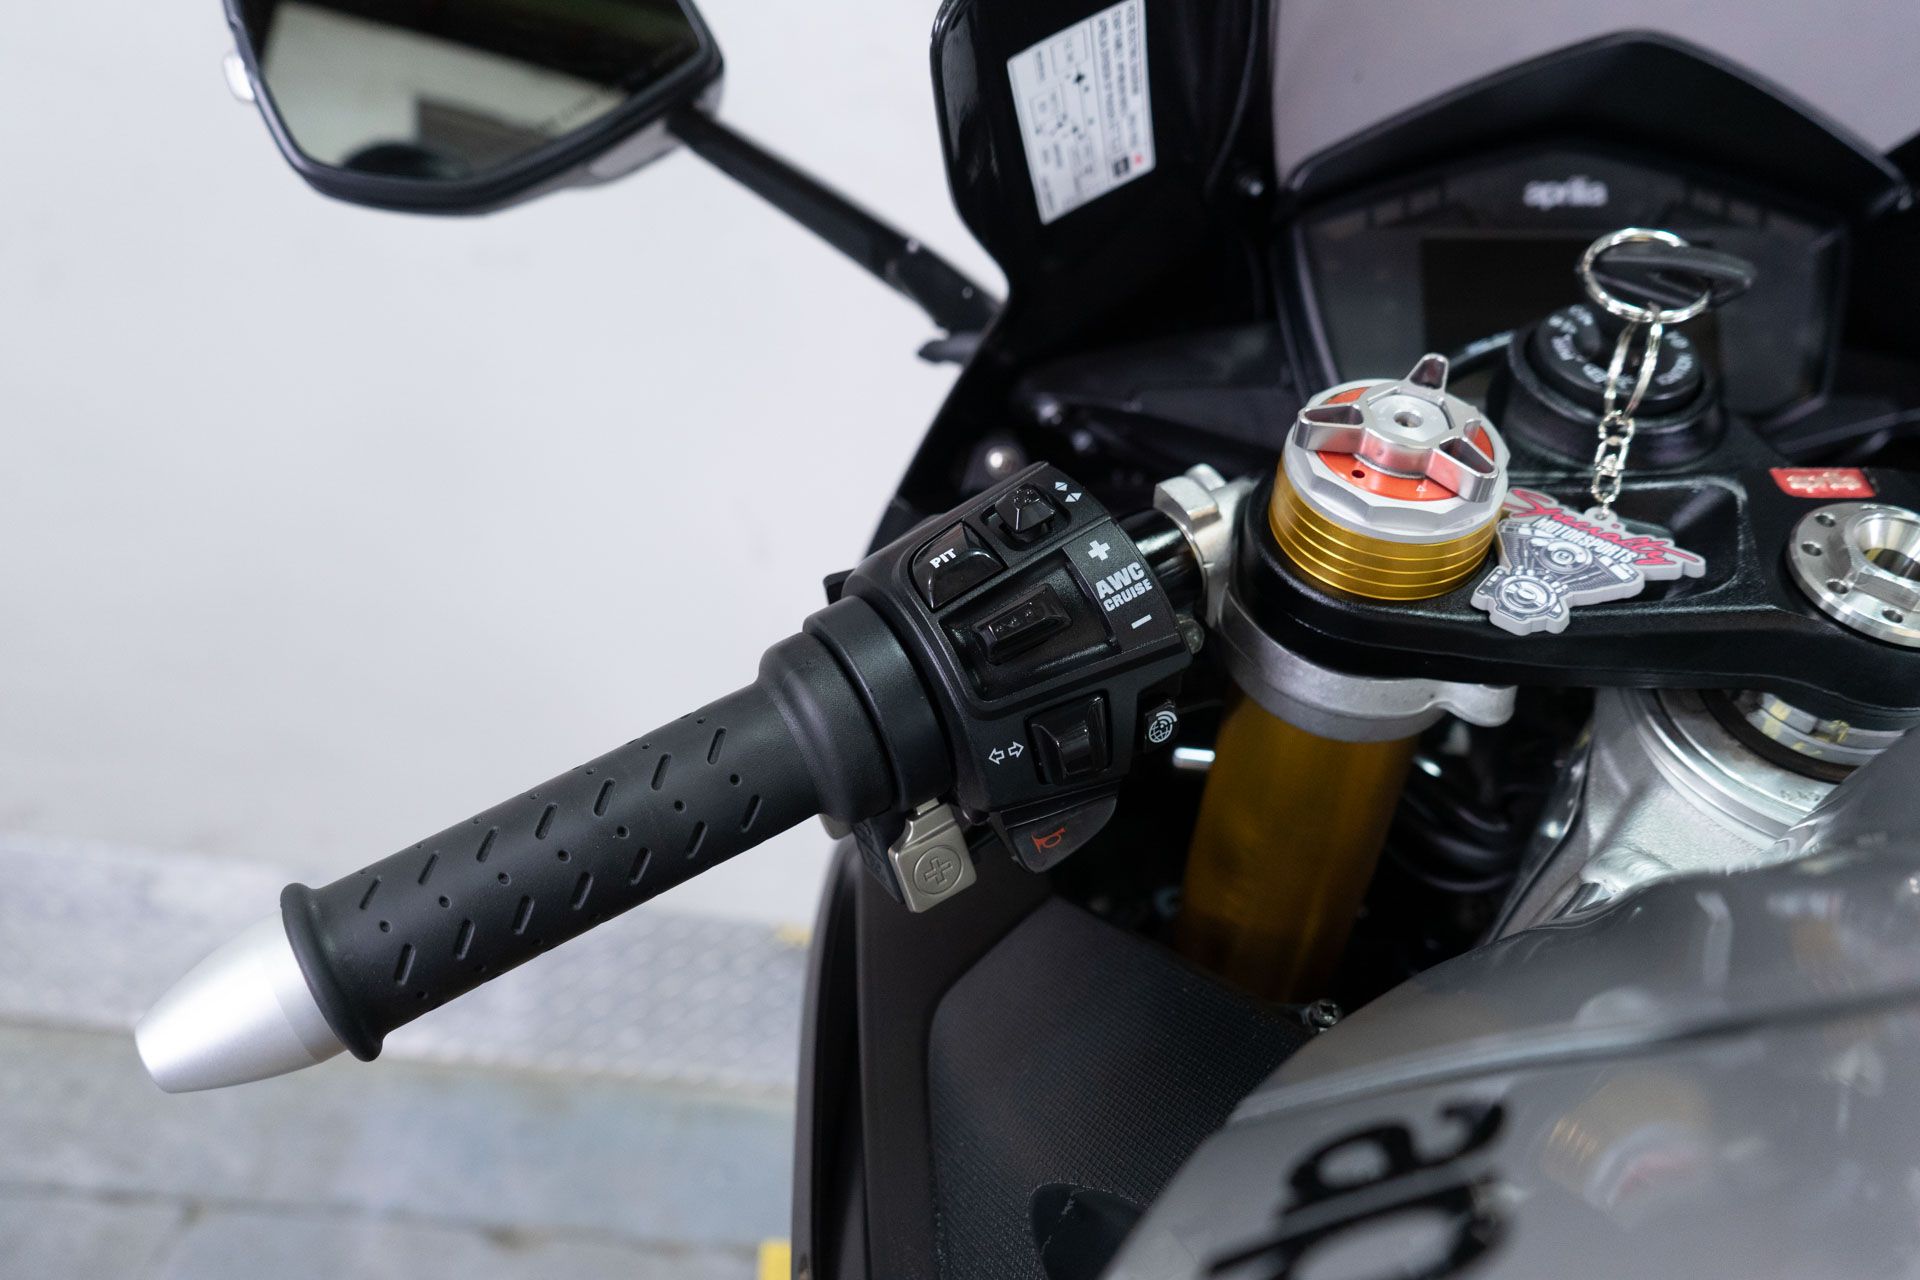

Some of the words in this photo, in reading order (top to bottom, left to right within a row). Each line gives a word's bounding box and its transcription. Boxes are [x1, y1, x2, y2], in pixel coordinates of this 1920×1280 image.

[929, 547, 958, 569] PIT
[1531, 515, 1639, 565] MOTORSPORTS
[1095, 561, 1146, 600] AWC
[1103, 577, 1154, 613] CRUISE
